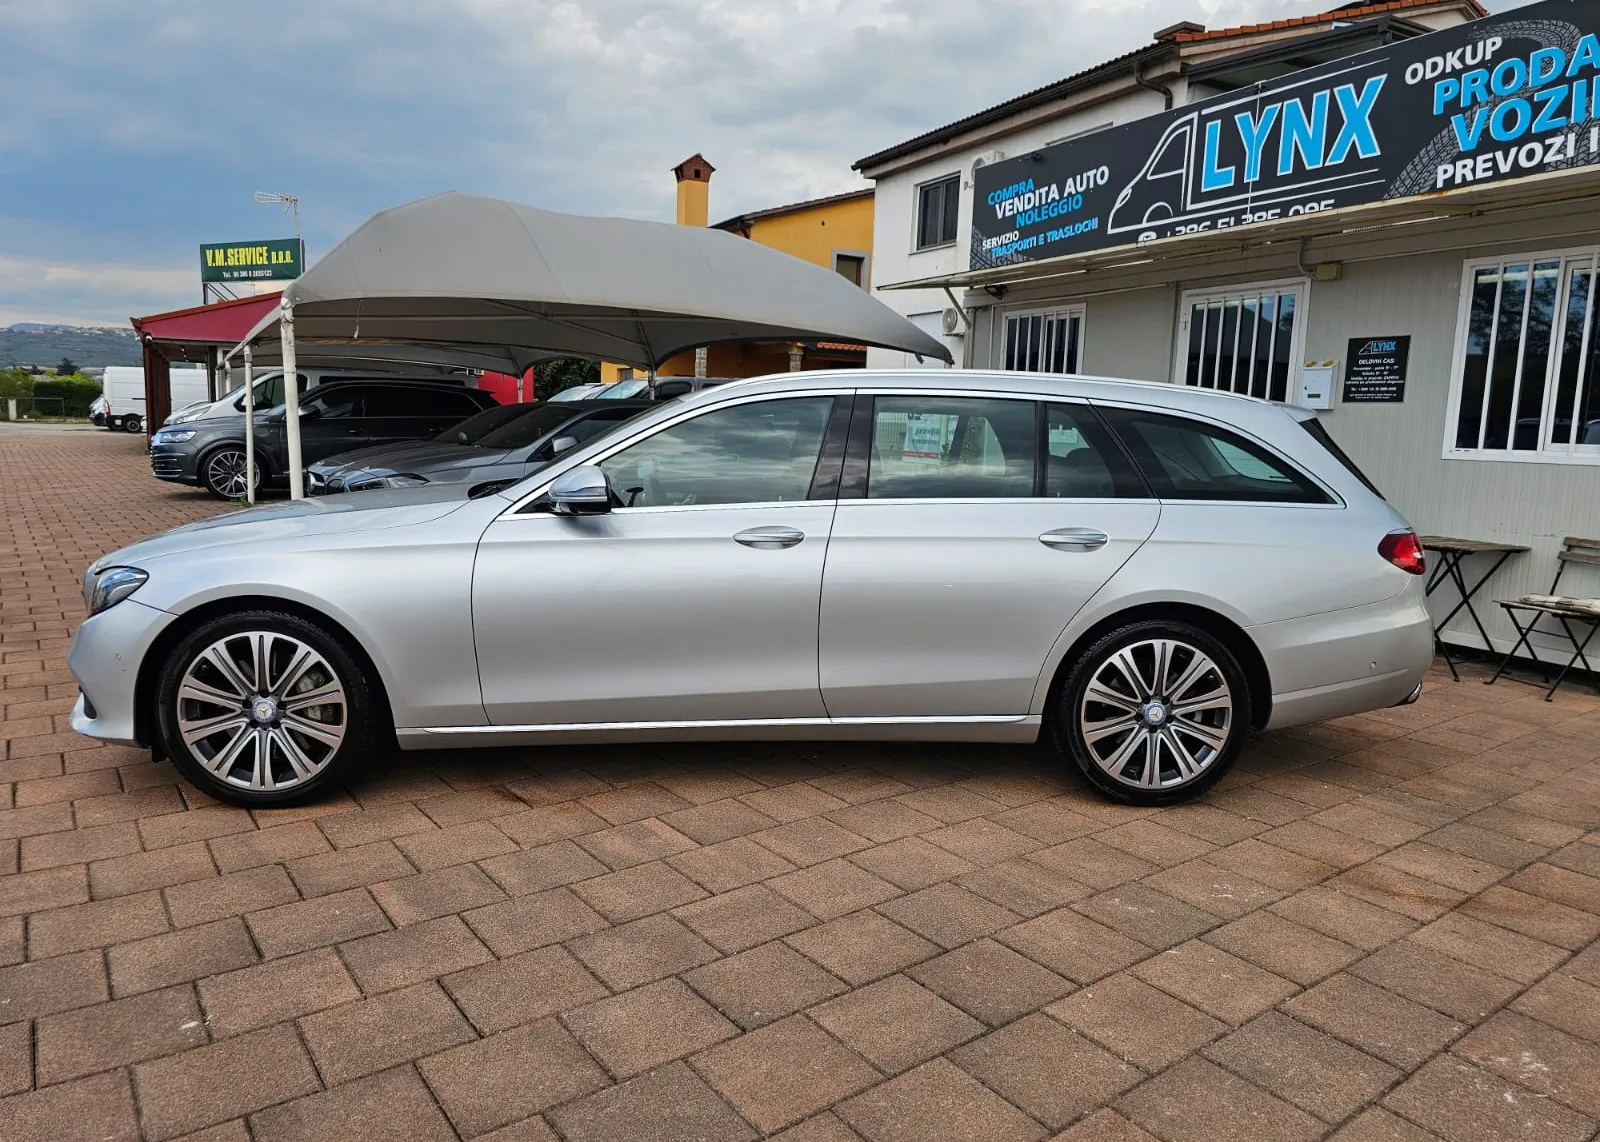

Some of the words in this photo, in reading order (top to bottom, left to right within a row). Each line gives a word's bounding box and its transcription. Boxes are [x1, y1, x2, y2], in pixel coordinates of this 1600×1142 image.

[1404, 37, 1503, 85] ODKUP
[1433, 33, 1600, 115] PRODA
[1201, 74, 1388, 193] LYNX
[1436, 132, 1576, 188] PREVOZI
[987, 178, 1035, 206] COMPRA
[995, 183, 1060, 219] VENDITA
[1063, 165, 1110, 198] AUTO
[1015, 193, 1083, 228] NOLEGGIO
[206, 246, 269, 267] V.M.SERVICE
[982, 230, 1020, 250] SERVIZIO
[991, 236, 1037, 258] TRASPORTI
[1038, 233, 1045, 246] E
[1046, 217, 1099, 243] TRASLOCHI
